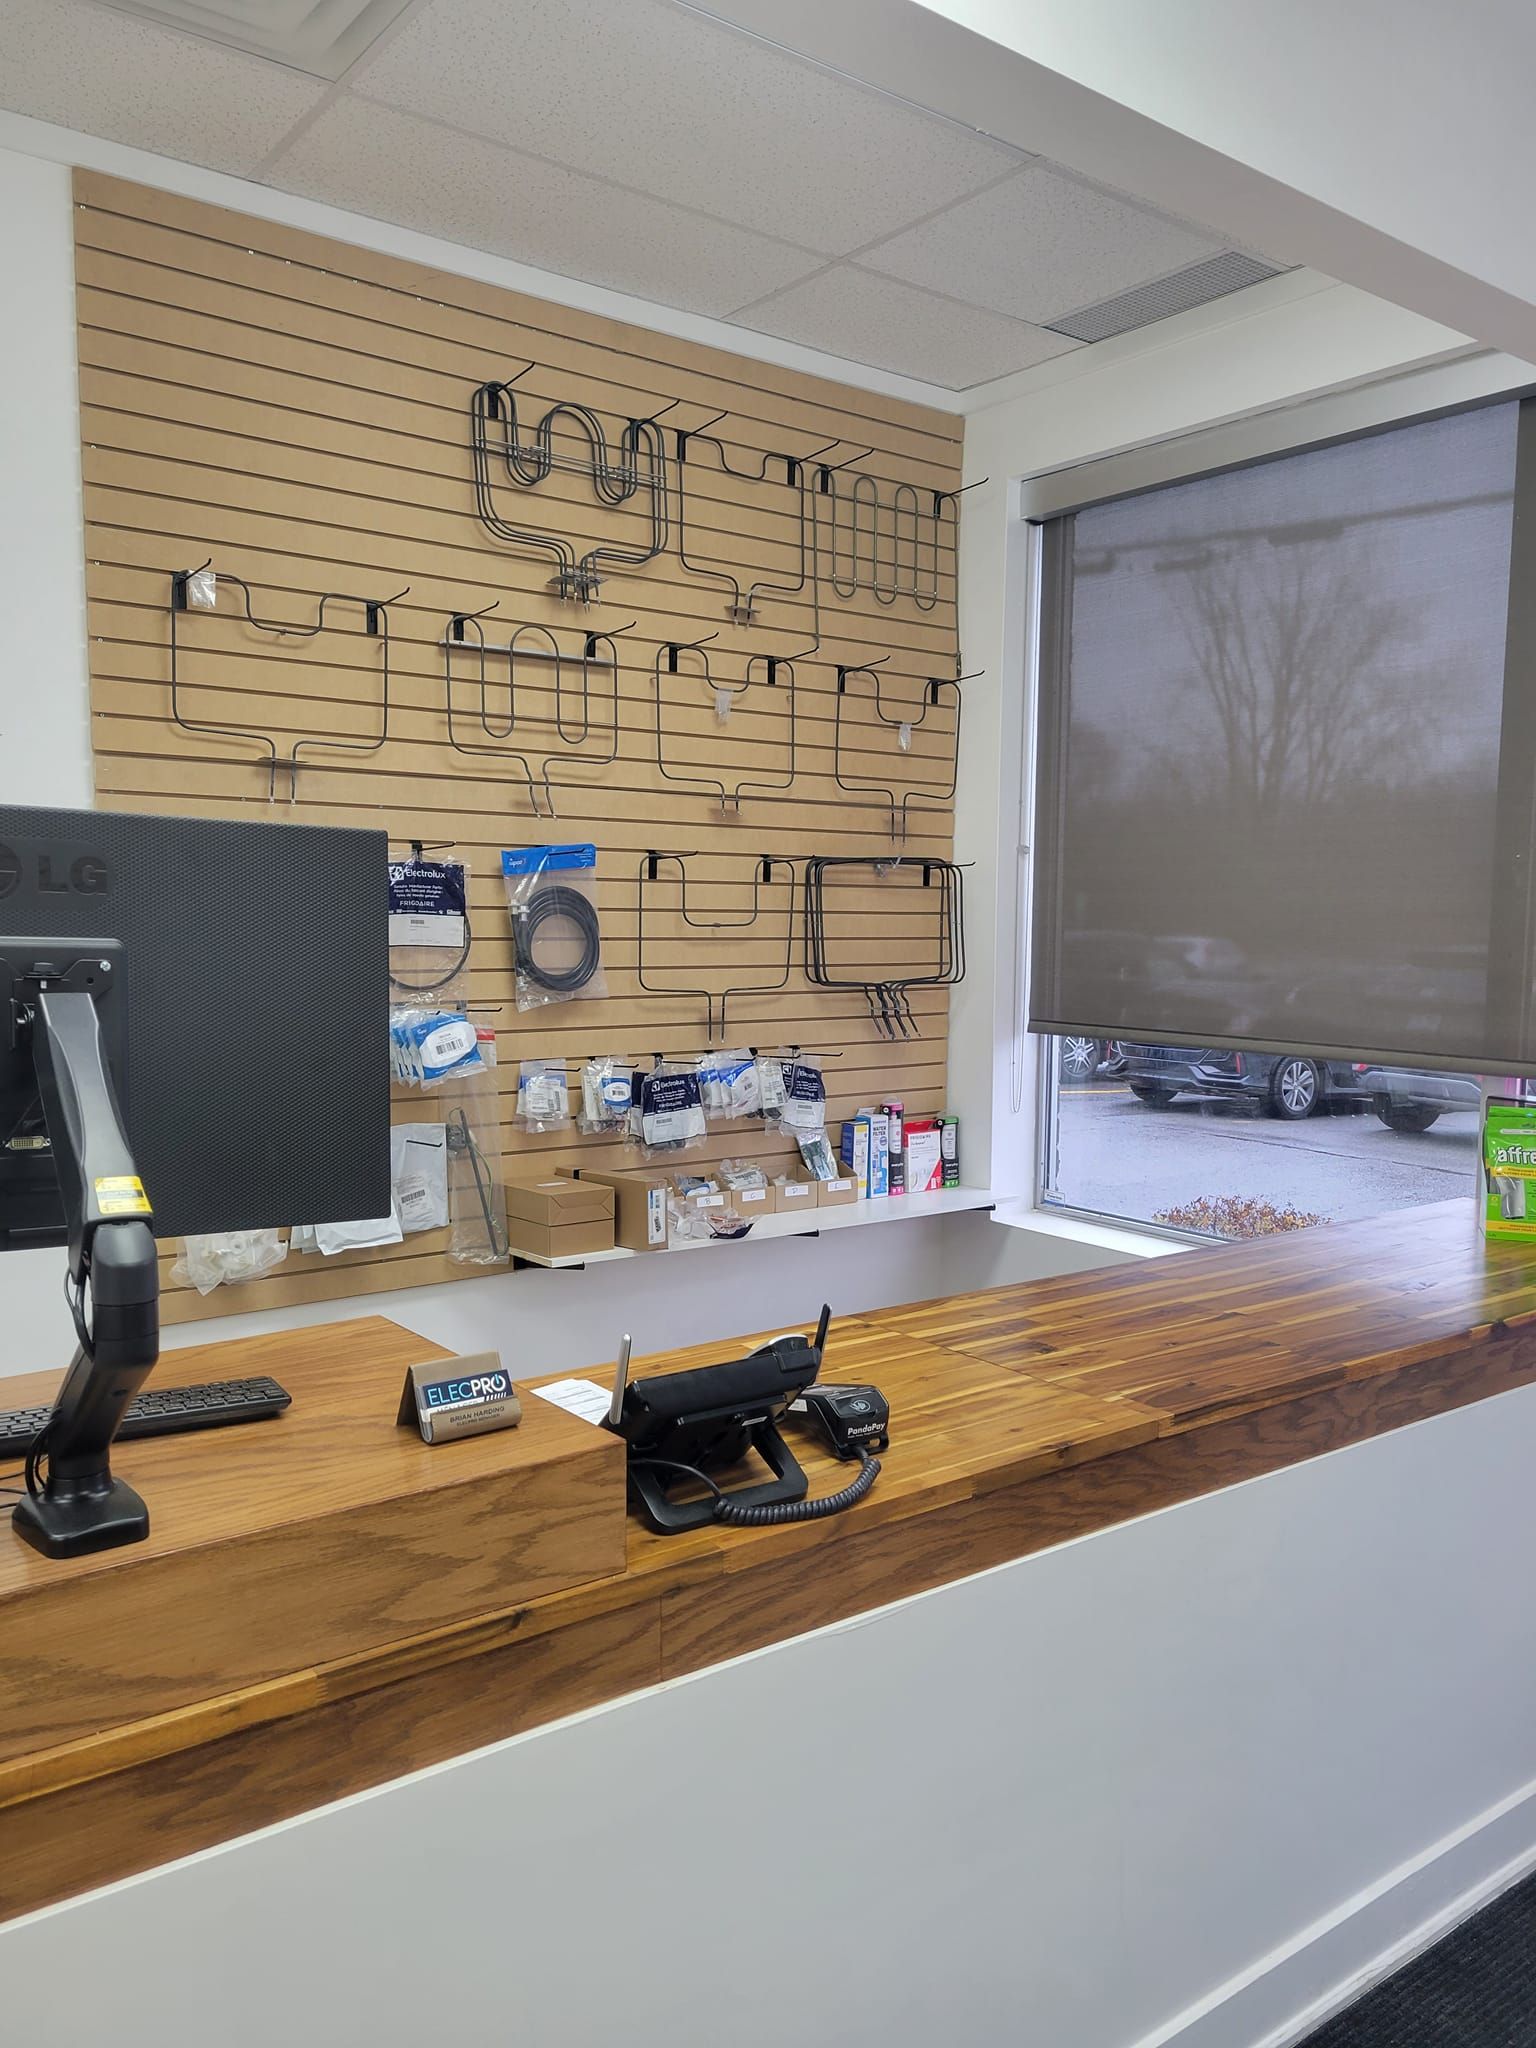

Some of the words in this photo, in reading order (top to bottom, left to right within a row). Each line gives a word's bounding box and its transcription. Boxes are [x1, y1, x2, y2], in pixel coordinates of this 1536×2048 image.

[38, 855, 107, 896] LG
[405, 868, 446, 879] Electrolux
[427, 1373, 507, 1406] ELECPRO
[473, 1405, 505, 1418] HARDING
[847, 1422, 886, 1436] PandaPay
